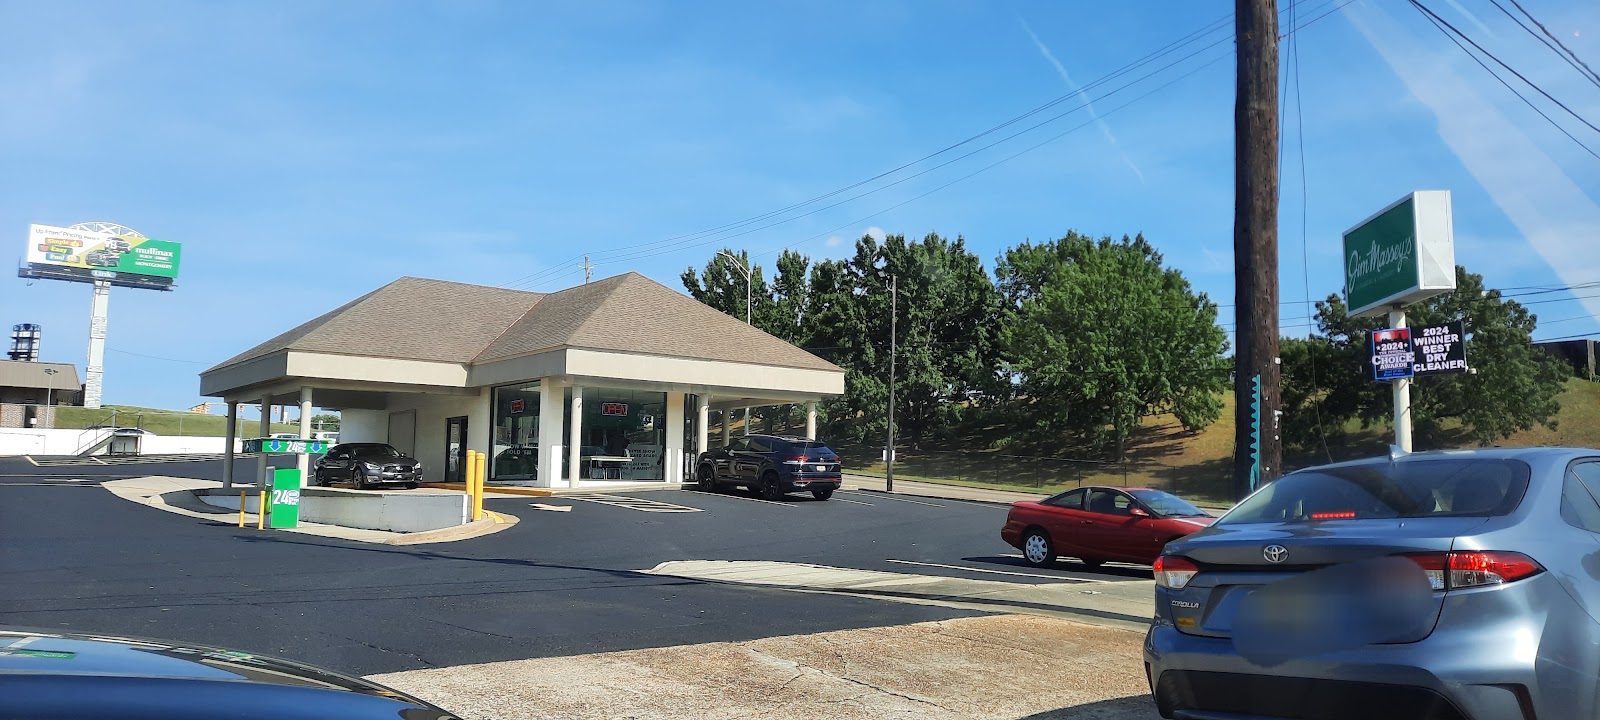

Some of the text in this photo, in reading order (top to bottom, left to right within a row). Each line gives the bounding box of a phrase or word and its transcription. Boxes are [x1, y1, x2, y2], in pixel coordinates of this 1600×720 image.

[62, 231, 82, 239] Pricing
[51, 246, 68, 254] Easy
[135, 248, 174, 257] mullinax
[135, 261, 173, 269] MONTGOMERY
[1348, 250, 1370, 293] Jim
[1366, 236, 1412, 273] Massey's
[1423, 326, 1449, 337] 2024
[1414, 333, 1459, 346] WINNER
[1381, 341, 1403, 351] 2024
[1422, 343, 1452, 354] BEST
[1371, 351, 1415, 365] CHOICE
[1426, 352, 1448, 362] DRY
[1380, 362, 1408, 370] AWARDS
[1413, 360, 1465, 372] CLEANER
[603, 404, 627, 415] OPEN
[286, 441, 299, 452] 24
[273, 489, 289, 504] 24
[1171, 600, 1200, 609] COROLLA
